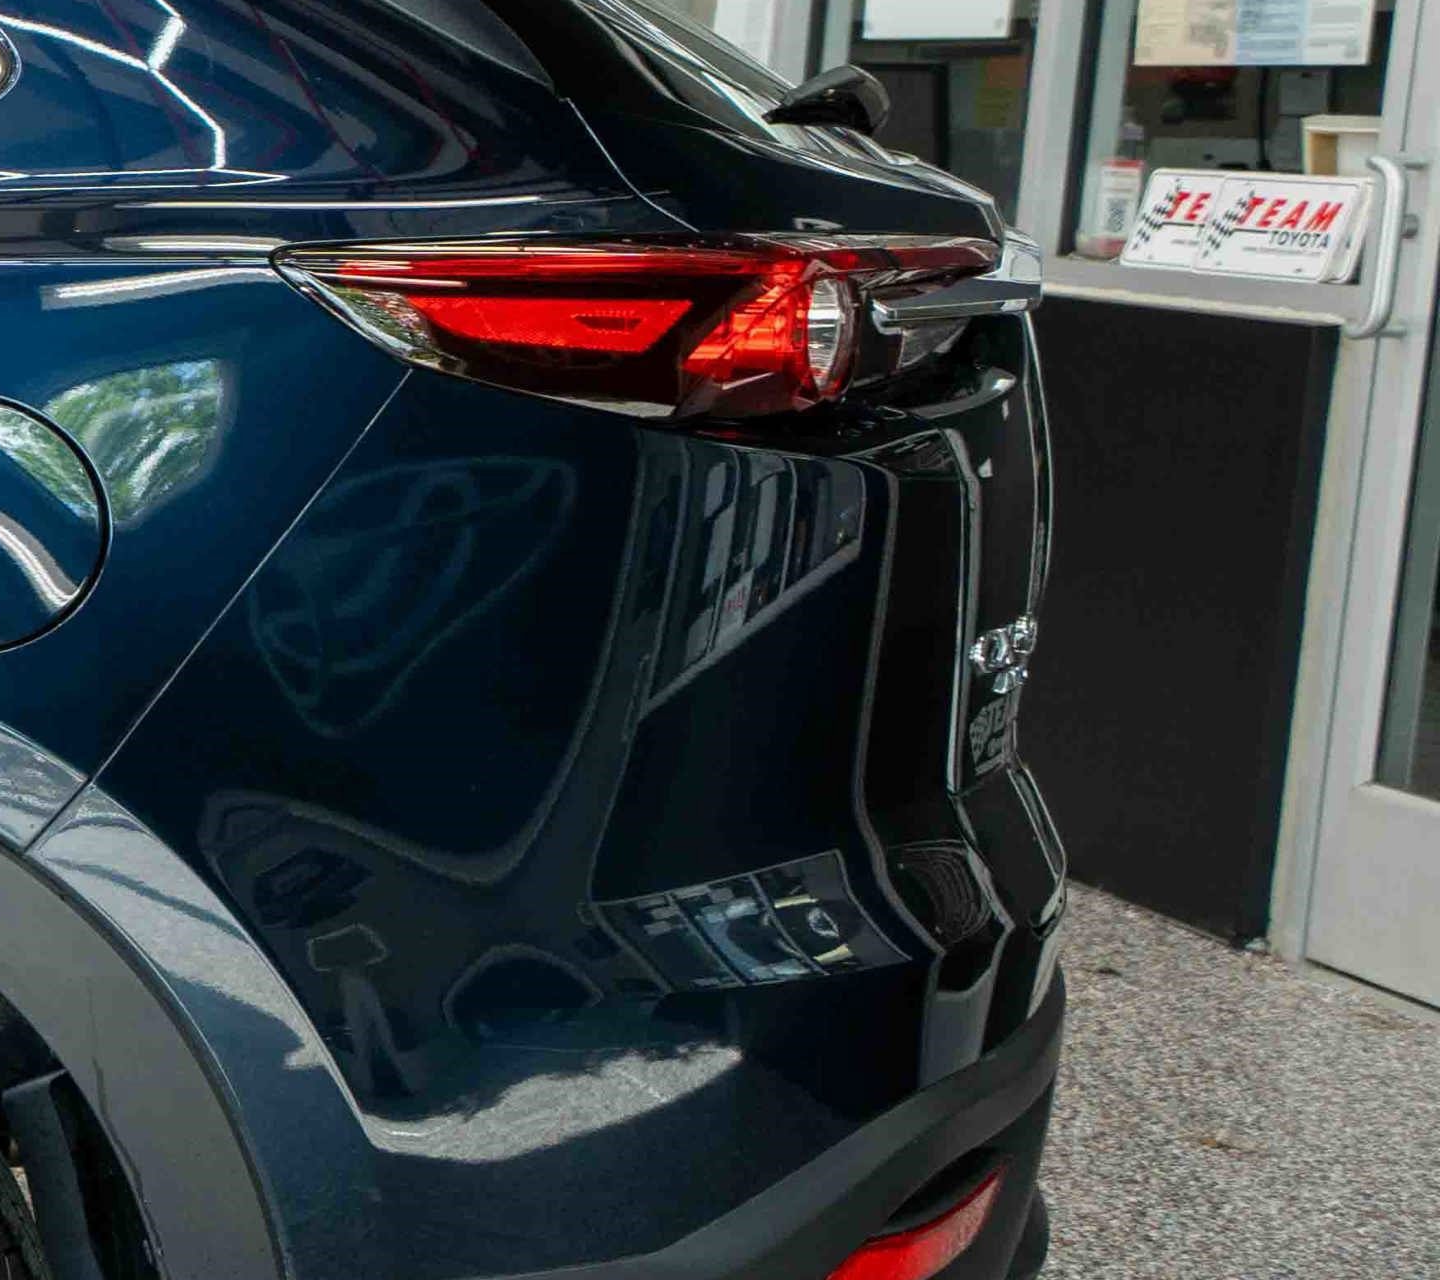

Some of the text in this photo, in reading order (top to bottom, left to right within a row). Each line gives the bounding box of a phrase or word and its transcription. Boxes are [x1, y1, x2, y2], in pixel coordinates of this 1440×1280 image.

[1166, 191, 1212, 222] TE
[1240, 195, 1344, 233] TEAM
[1268, 230, 1331, 249] TOYOTA
